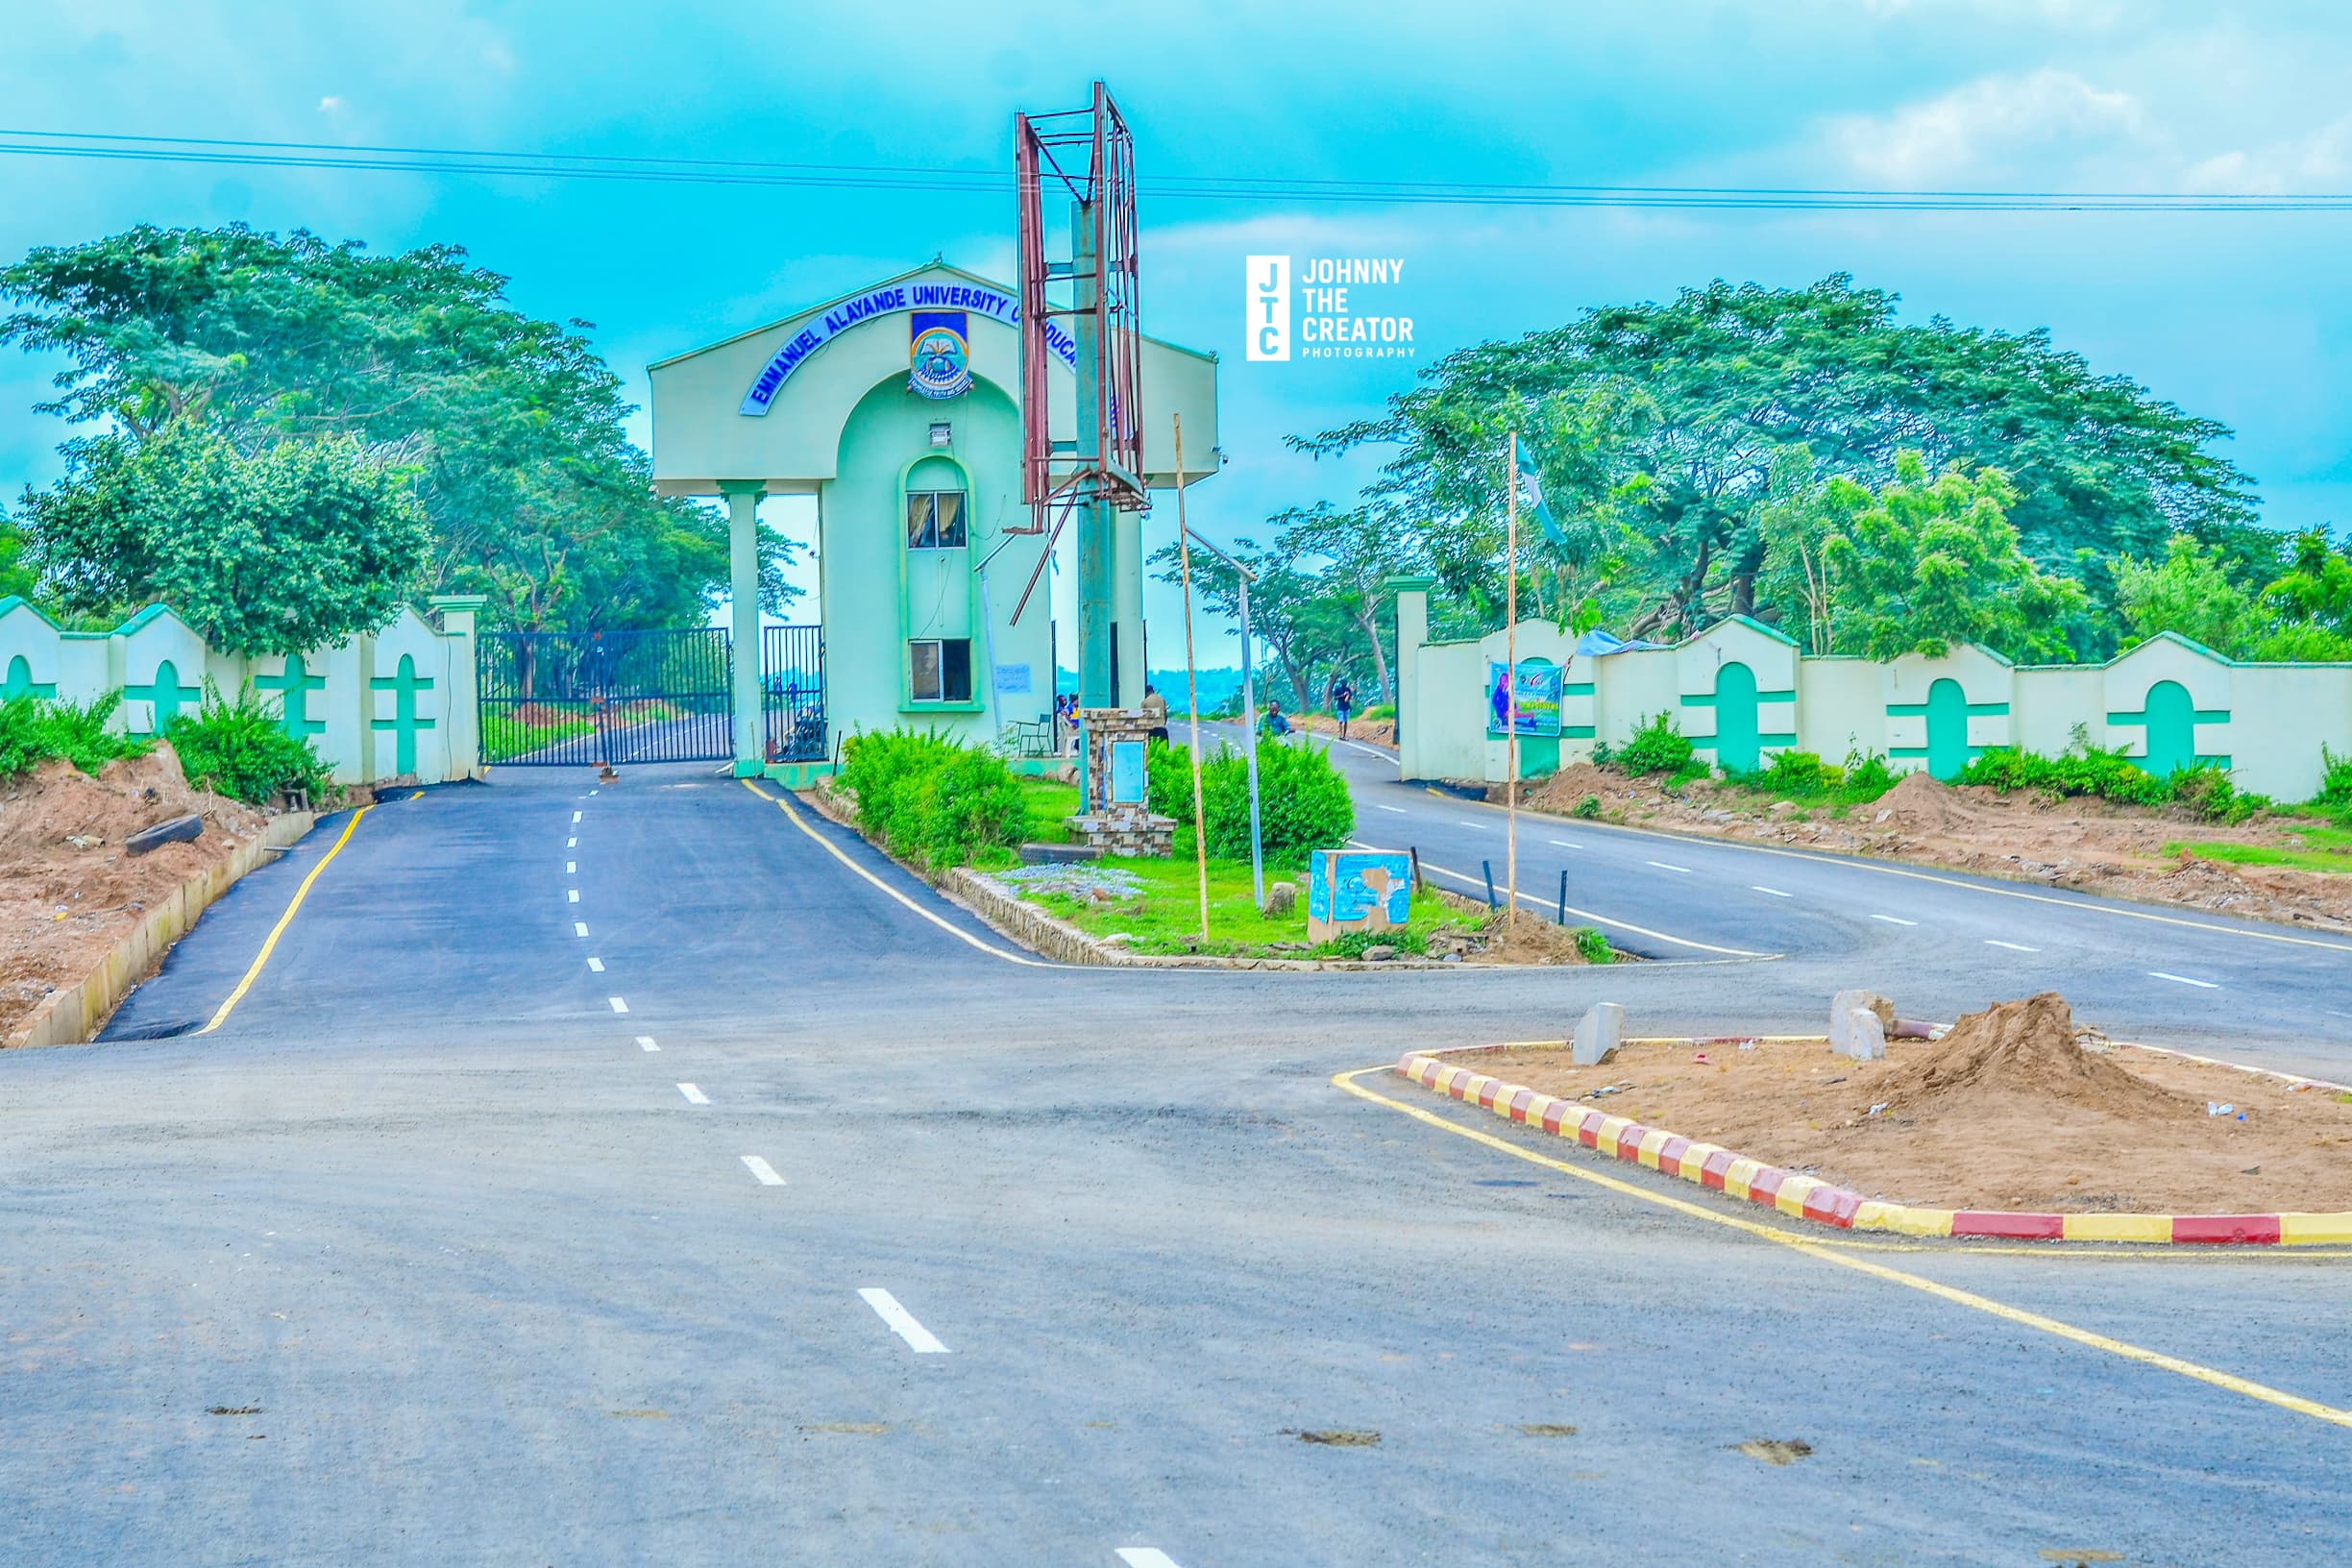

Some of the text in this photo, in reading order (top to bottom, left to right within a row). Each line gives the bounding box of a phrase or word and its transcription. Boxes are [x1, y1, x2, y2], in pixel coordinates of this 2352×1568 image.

[750, 329, 822, 404] EMMANUEL
[824, 288, 906, 333] ALAYANDE
[913, 285, 1008, 315] UNIVERSITY
